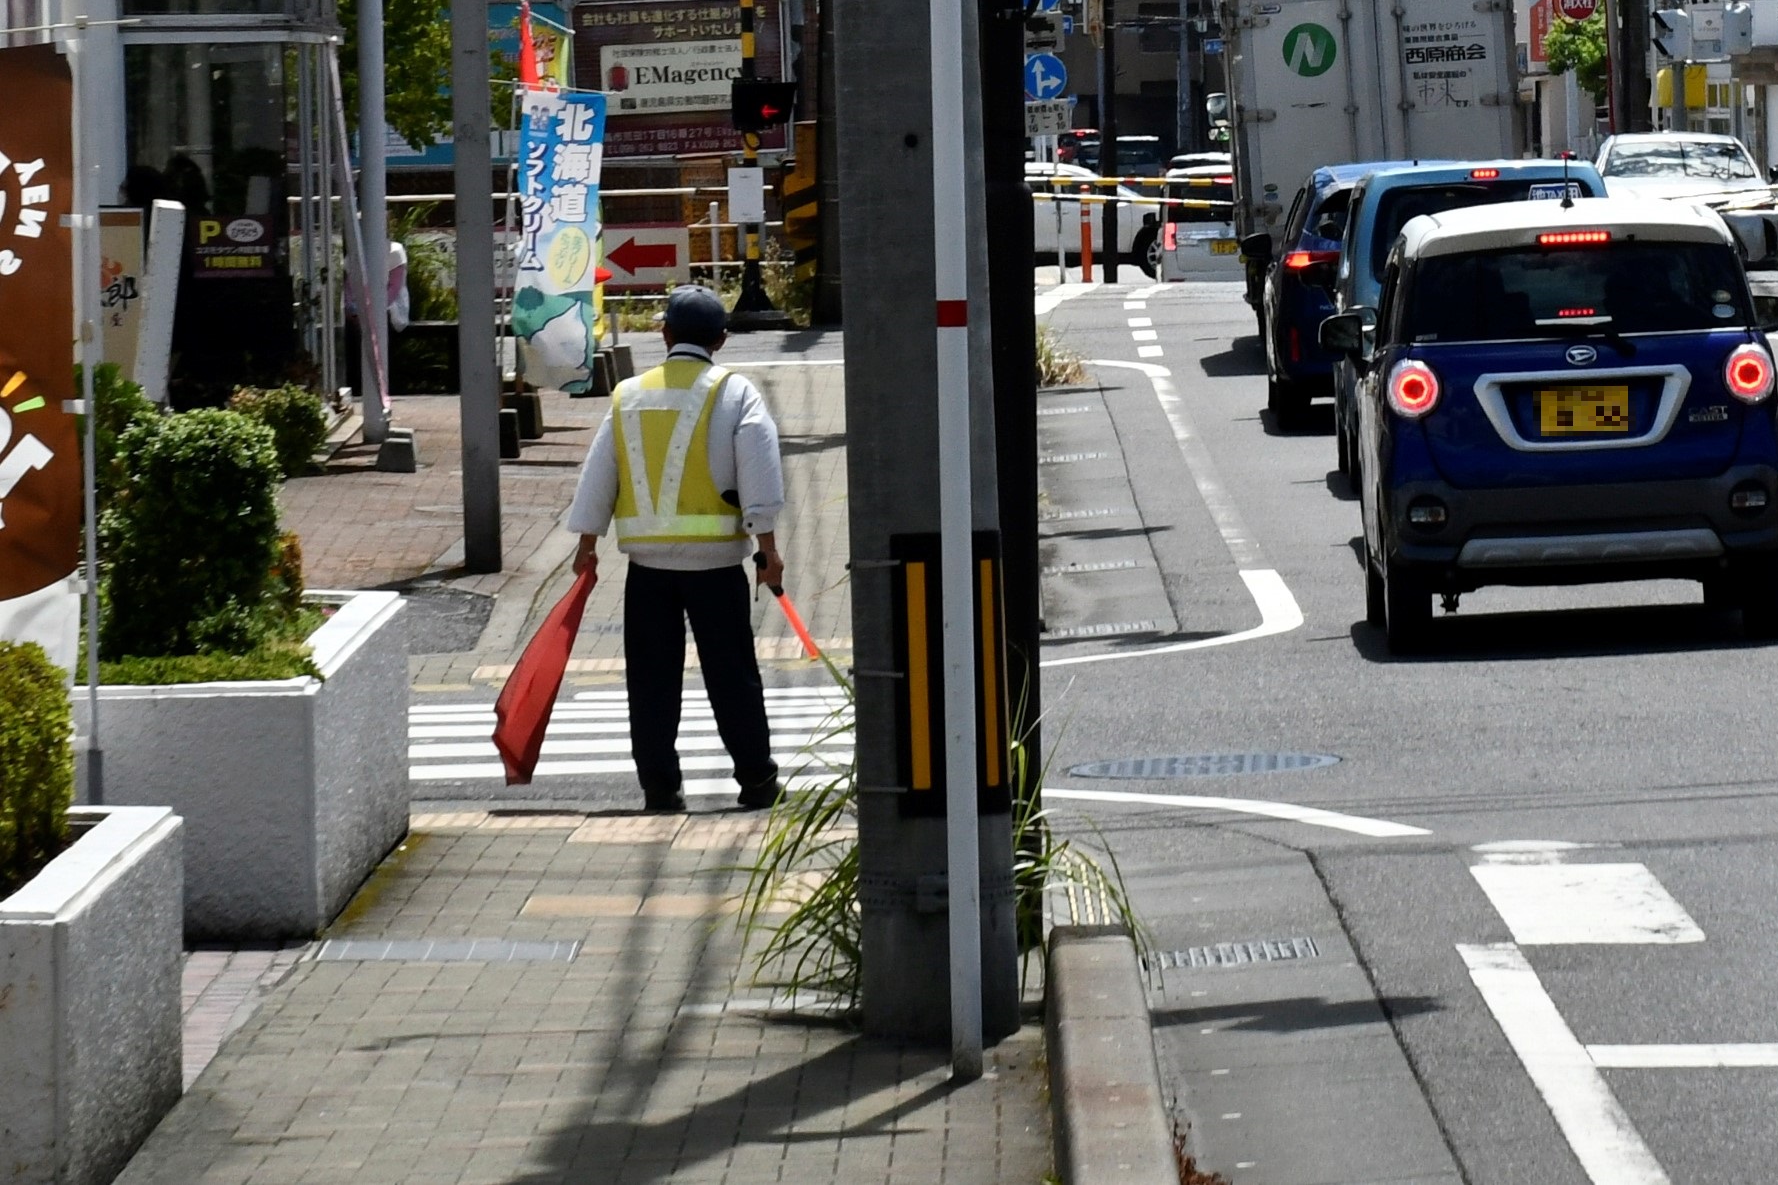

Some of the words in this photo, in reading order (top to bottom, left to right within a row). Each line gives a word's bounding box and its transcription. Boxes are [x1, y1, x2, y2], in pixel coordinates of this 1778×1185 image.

[1405, 43, 1486, 65] 西原商会
[551, 103, 595, 223] 北海道
[199, 220, 222, 244] P
[520, 141, 548, 271] ソフトクリーム
